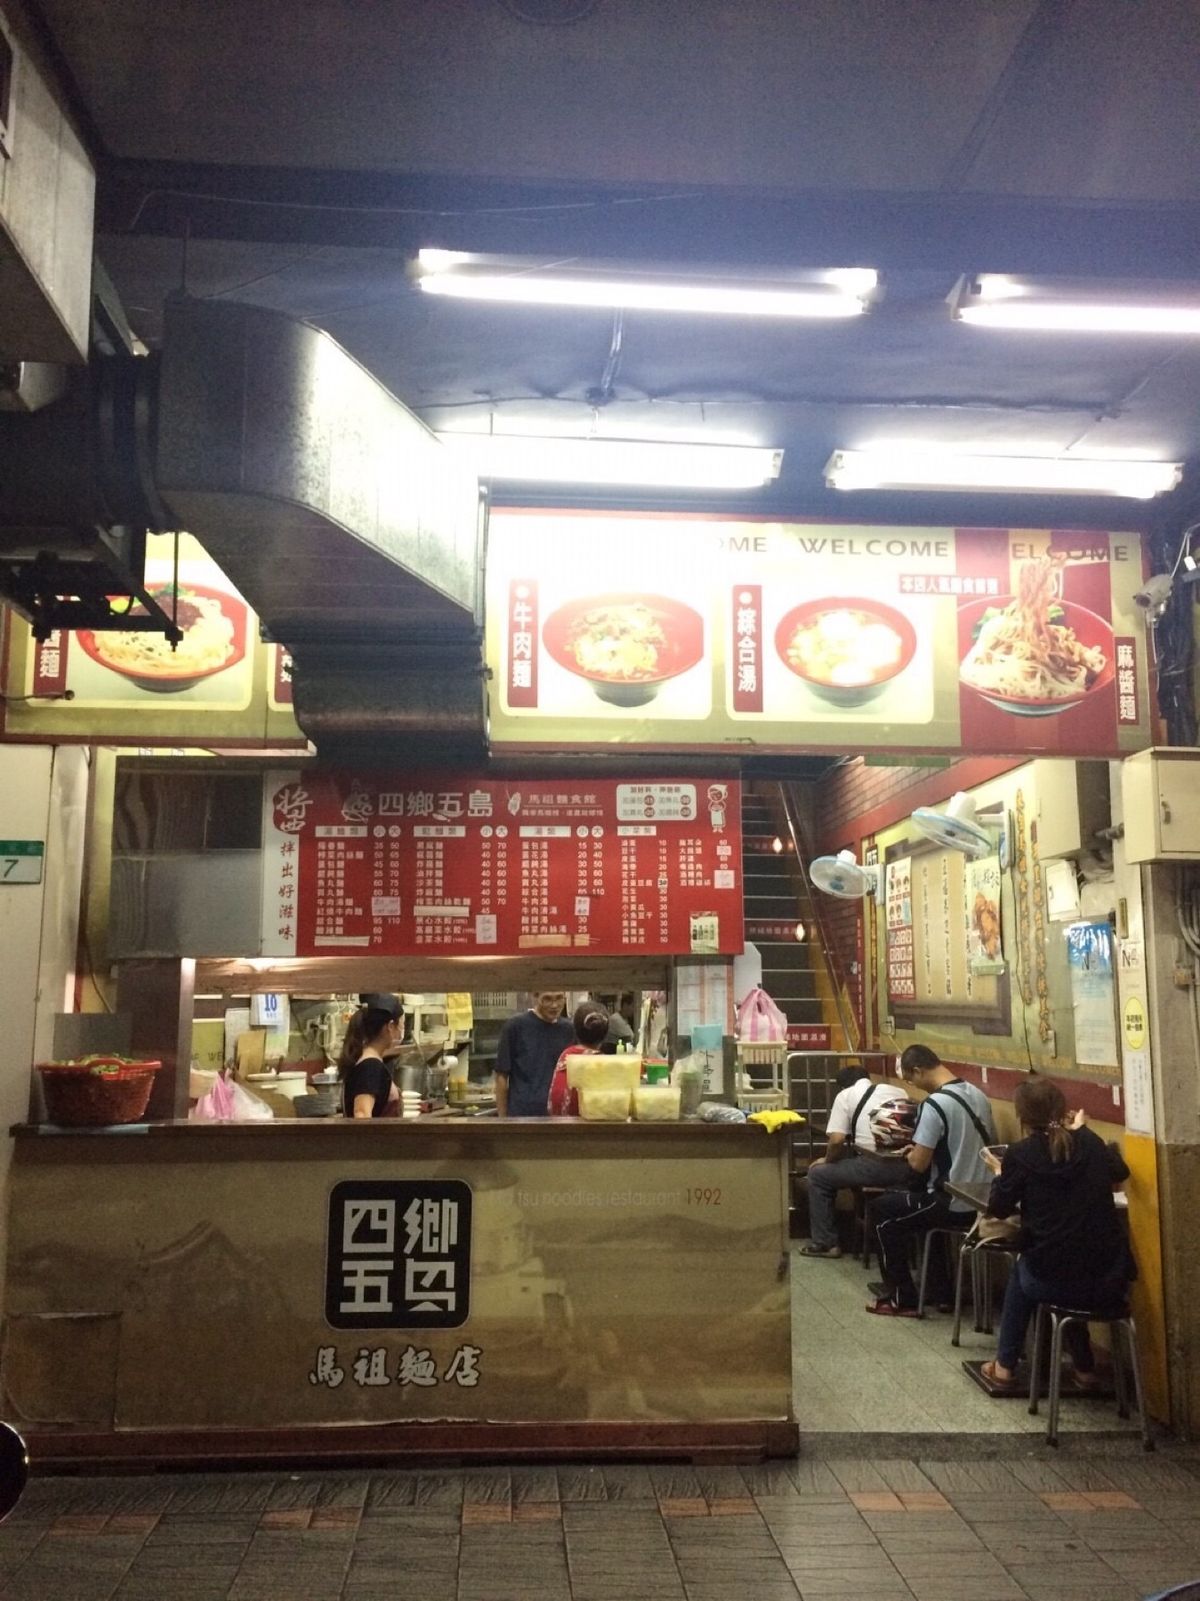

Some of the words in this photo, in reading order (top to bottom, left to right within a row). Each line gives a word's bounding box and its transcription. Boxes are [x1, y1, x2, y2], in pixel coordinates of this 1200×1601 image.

[799, 537, 949, 558] WELCOME
[737, 608, 757, 692] 綜合湯
[1117, 645, 1136, 720] 麻醬麵
[378, 790, 493, 820] 四鄉五島
[4, 859, 19, 878] 7
[278, 842, 296, 941] 拌出好滋味
[686, 1188, 722, 1206] 1992
[308, 1345, 484, 1388] 馬祖麵店
